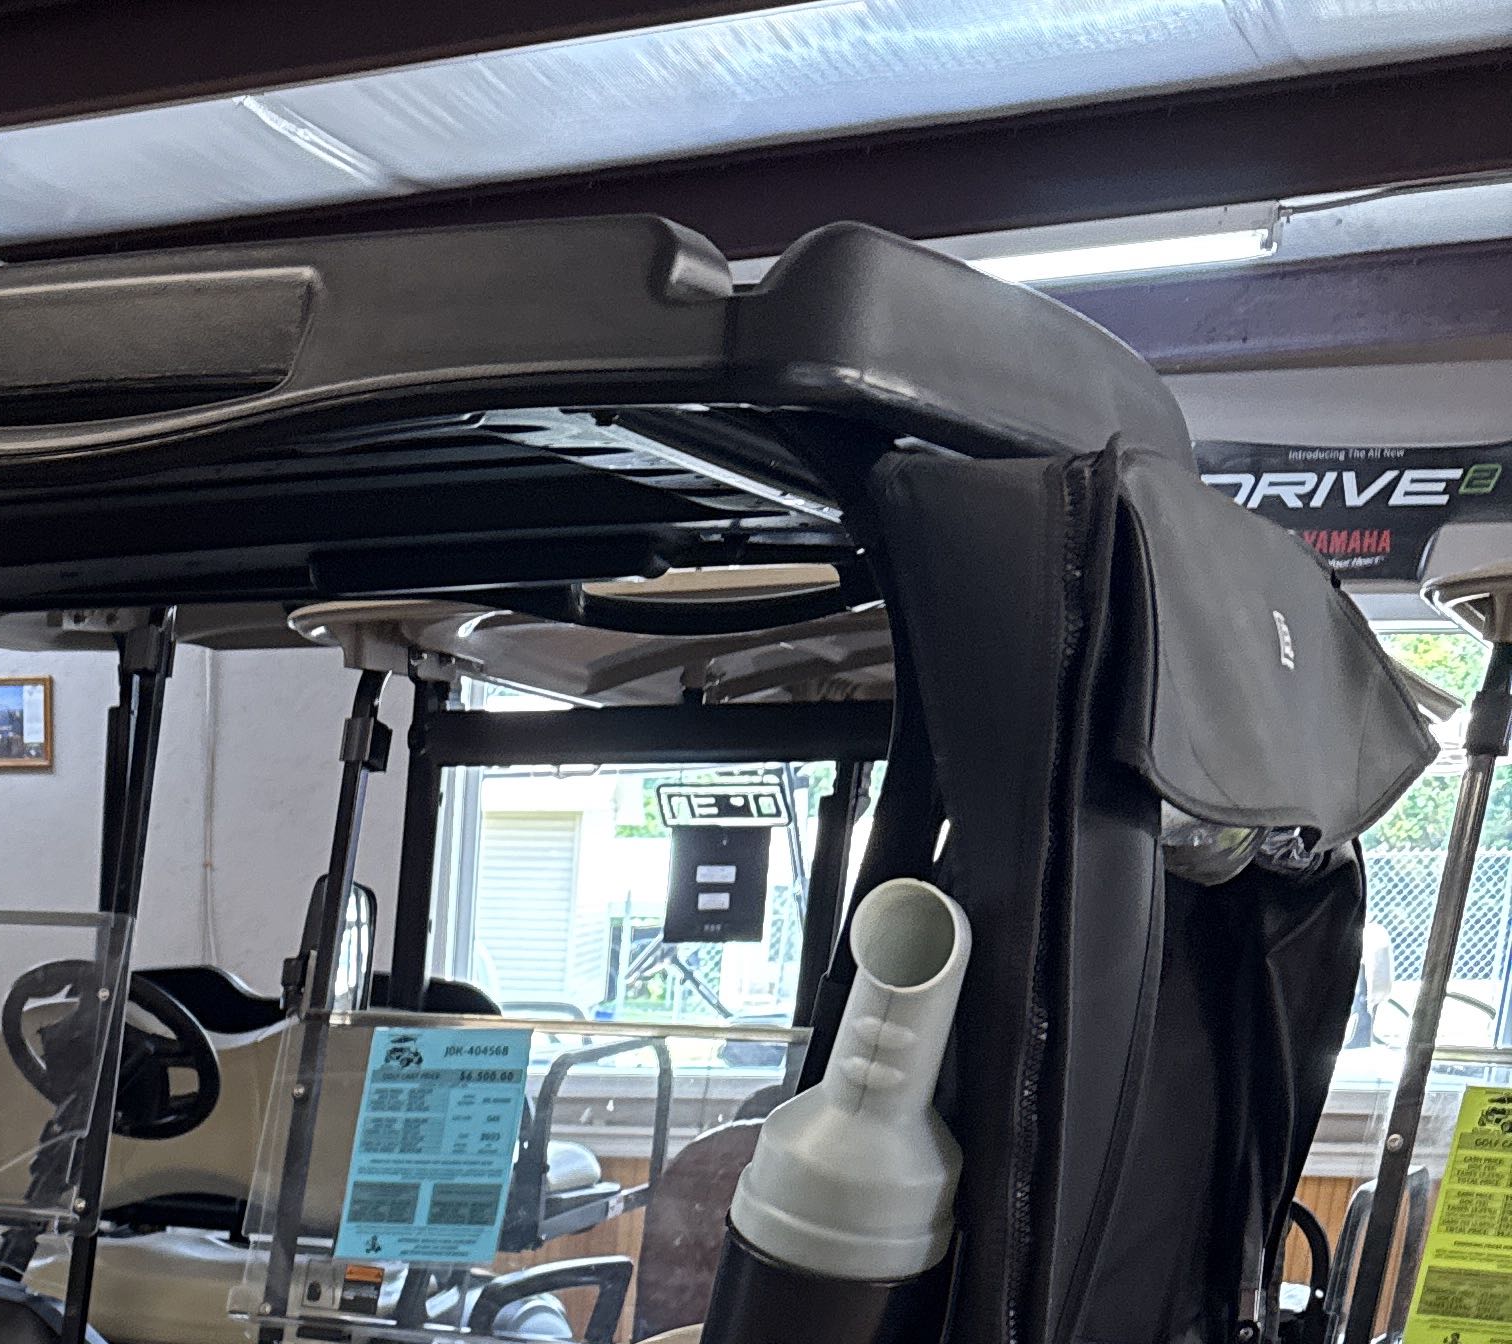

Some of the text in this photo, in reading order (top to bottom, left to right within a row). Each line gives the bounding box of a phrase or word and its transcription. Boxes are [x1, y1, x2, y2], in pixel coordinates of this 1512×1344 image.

[1289, 447, 1405, 461] Introducing The All New
[1303, 529, 1391, 554] YAMAHA
[1475, 1138, 1498, 1147] GOLF
